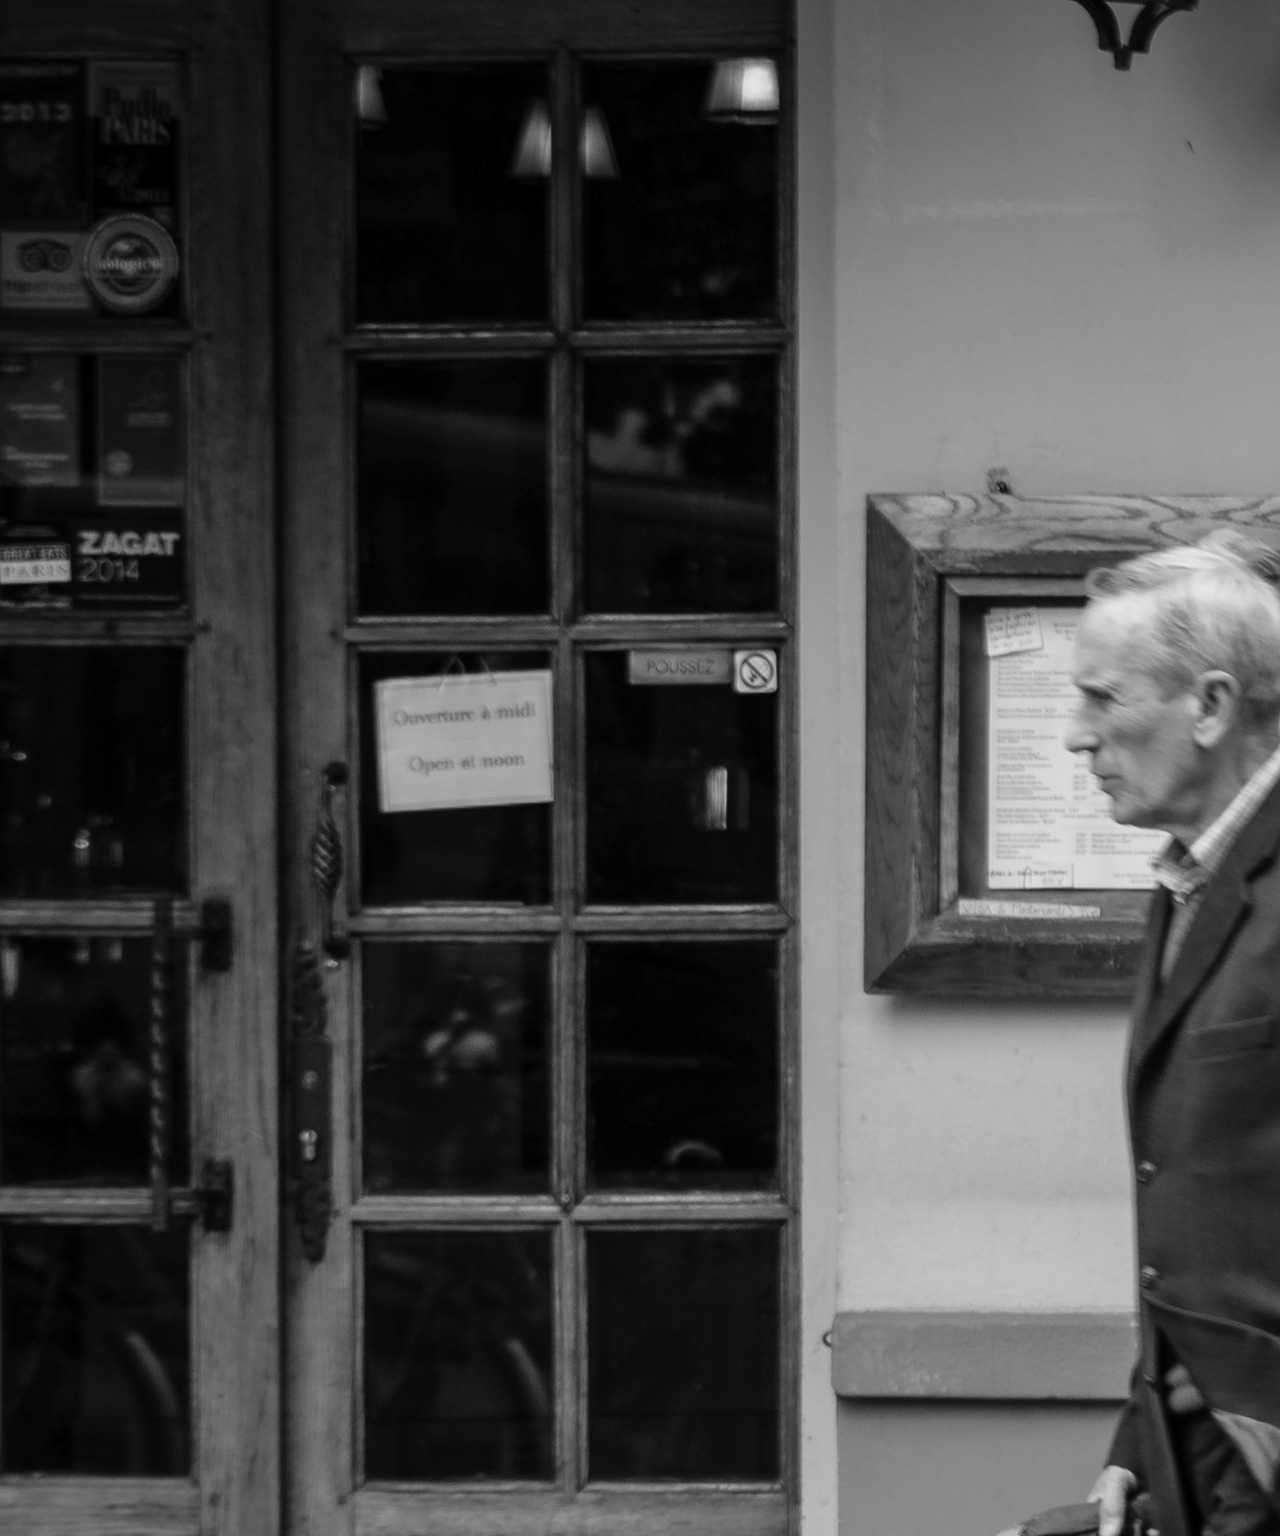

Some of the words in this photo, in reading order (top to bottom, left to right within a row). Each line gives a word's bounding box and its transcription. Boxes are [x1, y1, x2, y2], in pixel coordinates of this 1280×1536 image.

[102, 115, 172, 147] PARIS
[78, 529, 182, 557] ZAGAT
[4, 564, 70, 579] PARIS
[78, 557, 140, 582] 2014
[646, 659, 716, 676] POUSSEZ
[393, 709, 476, 727] Ouverture
[480, 706, 492, 720] à
[497, 702, 536, 719] midi
[407, 755, 455, 776] Open
[460, 756, 476, 769] at
[482, 754, 526, 768] noon
